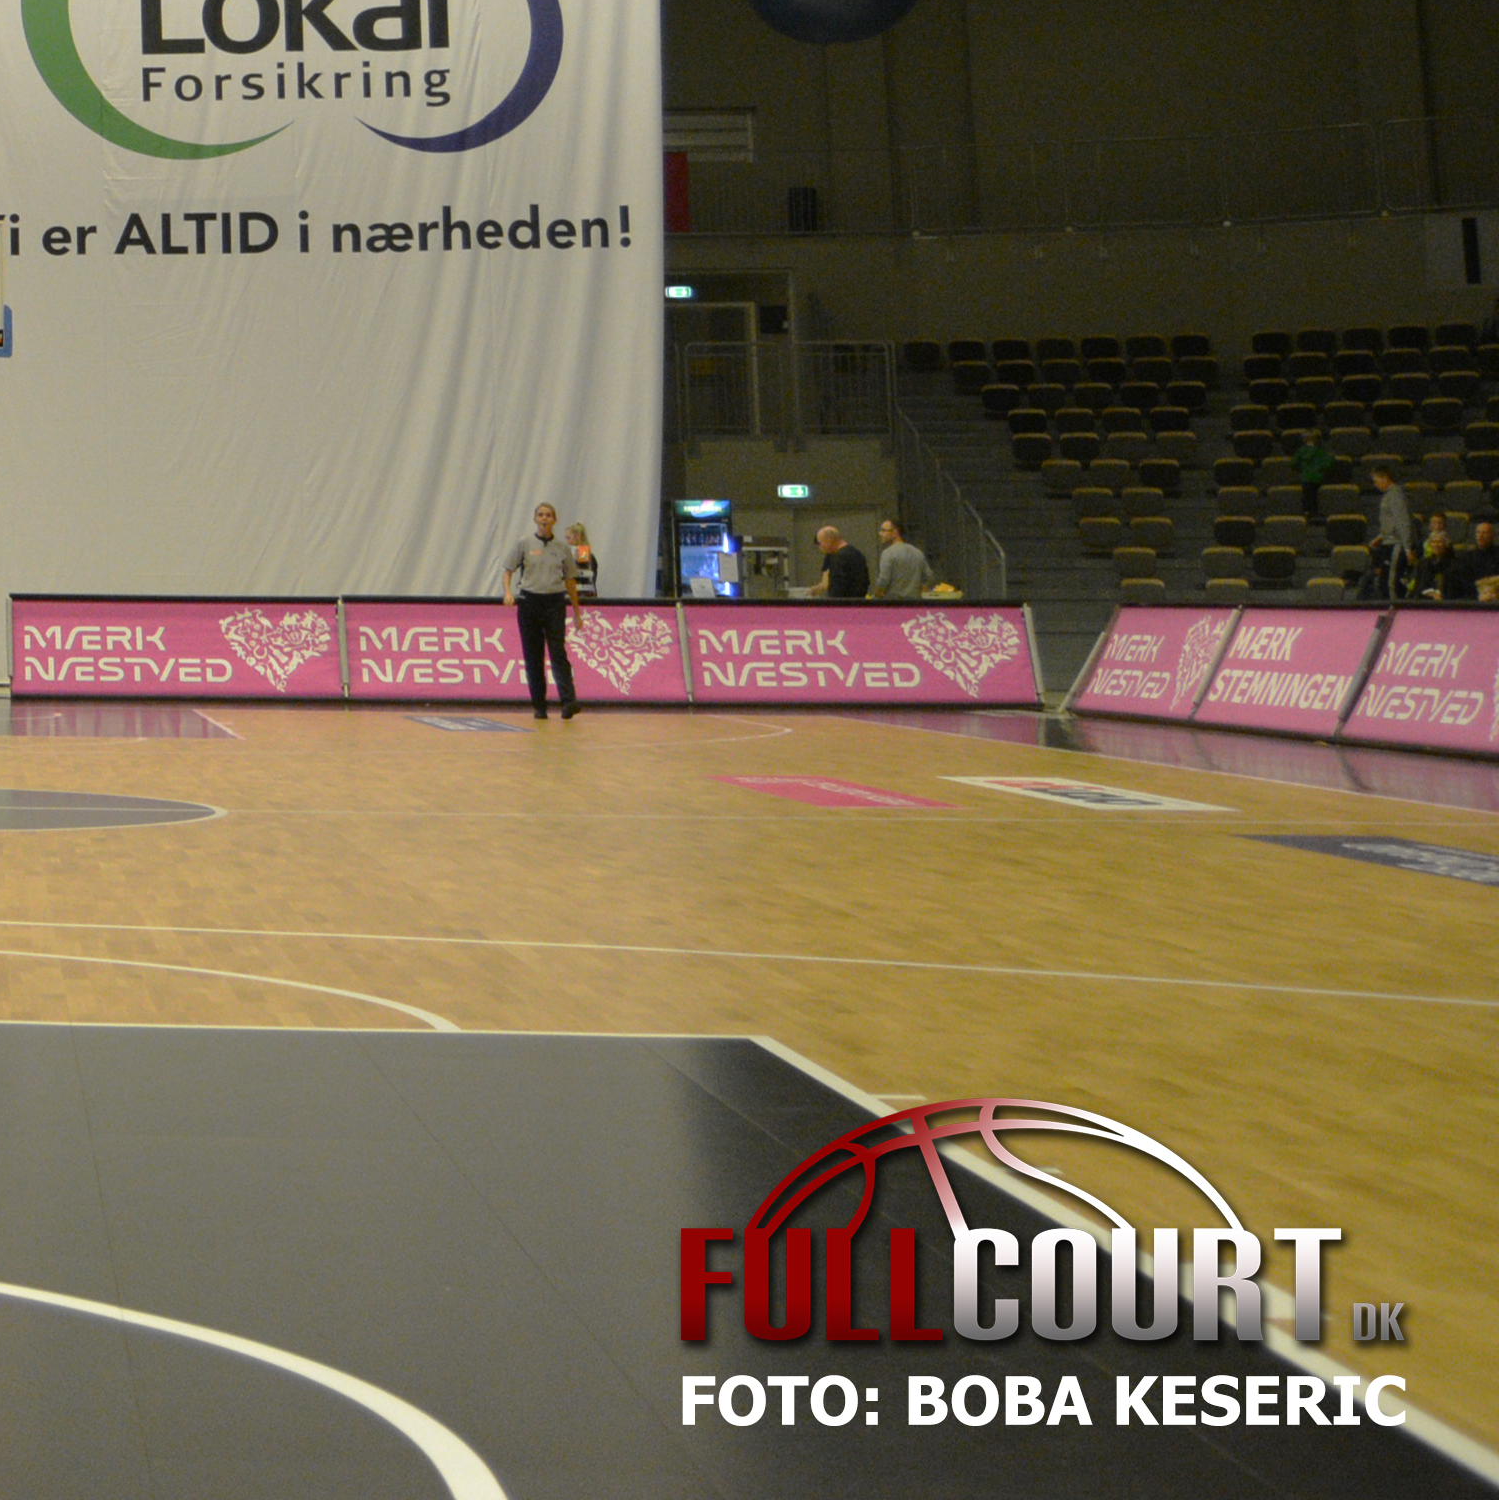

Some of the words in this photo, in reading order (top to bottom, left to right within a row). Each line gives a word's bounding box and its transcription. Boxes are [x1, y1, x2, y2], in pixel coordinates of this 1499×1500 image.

[141, 60, 452, 107] Forsikring
[41, 221, 97, 257] er
[114, 211, 279, 256] ALTID
[298, 210, 310, 254] i
[331, 204, 634, 254] nærheden!
[23, 625, 166, 652] MÆRK
[359, 626, 505, 653] MÆRK
[698, 629, 849, 656] MÆRK
[1104, 633, 1166, 663] MÆRK
[1229, 626, 1303, 661] MÆRK
[23, 657, 233, 683] NÆSTVED
[702, 662, 921, 688] NÆSTVED
[1377, 641, 1470, 679] MÆRK
[1087, 667, 1171, 699] NÆSTVED
[1208, 668, 1353, 711] STEMNINGEN
[1357, 684, 1485, 726] NÆSTVED
